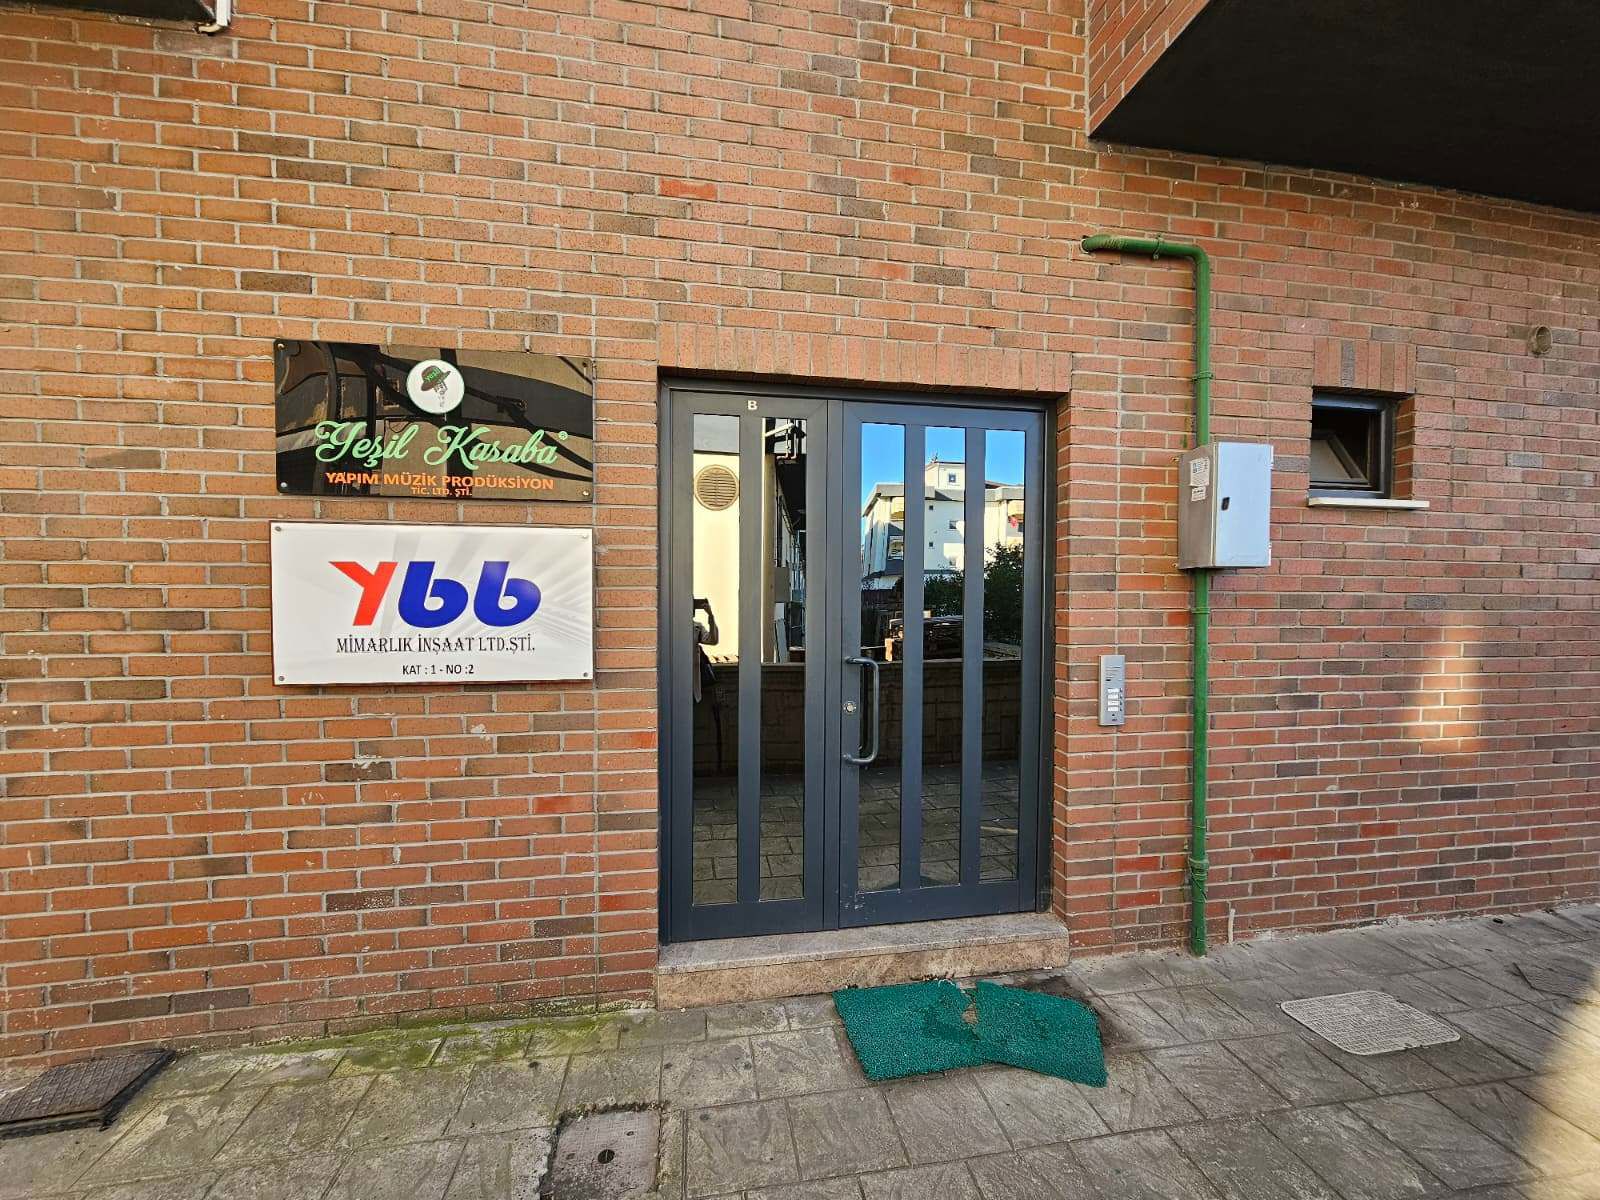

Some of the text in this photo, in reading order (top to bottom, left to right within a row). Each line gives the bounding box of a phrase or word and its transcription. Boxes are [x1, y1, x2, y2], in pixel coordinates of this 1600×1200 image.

[747, 399, 758, 411] B
[315, 420, 558, 470] Yeşil Kasaba
[325, 471, 554, 490] YAPIM MÜZİK PRODÜKSİYON
[410, 485, 473, 498] TİC. LTD. ŞTİ.
[336, 634, 413, 653] MİMARLIK
[417, 633, 474, 655] İNŞAAT
[402, 665, 421, 675] KAT
[446, 664, 462, 674] NO
